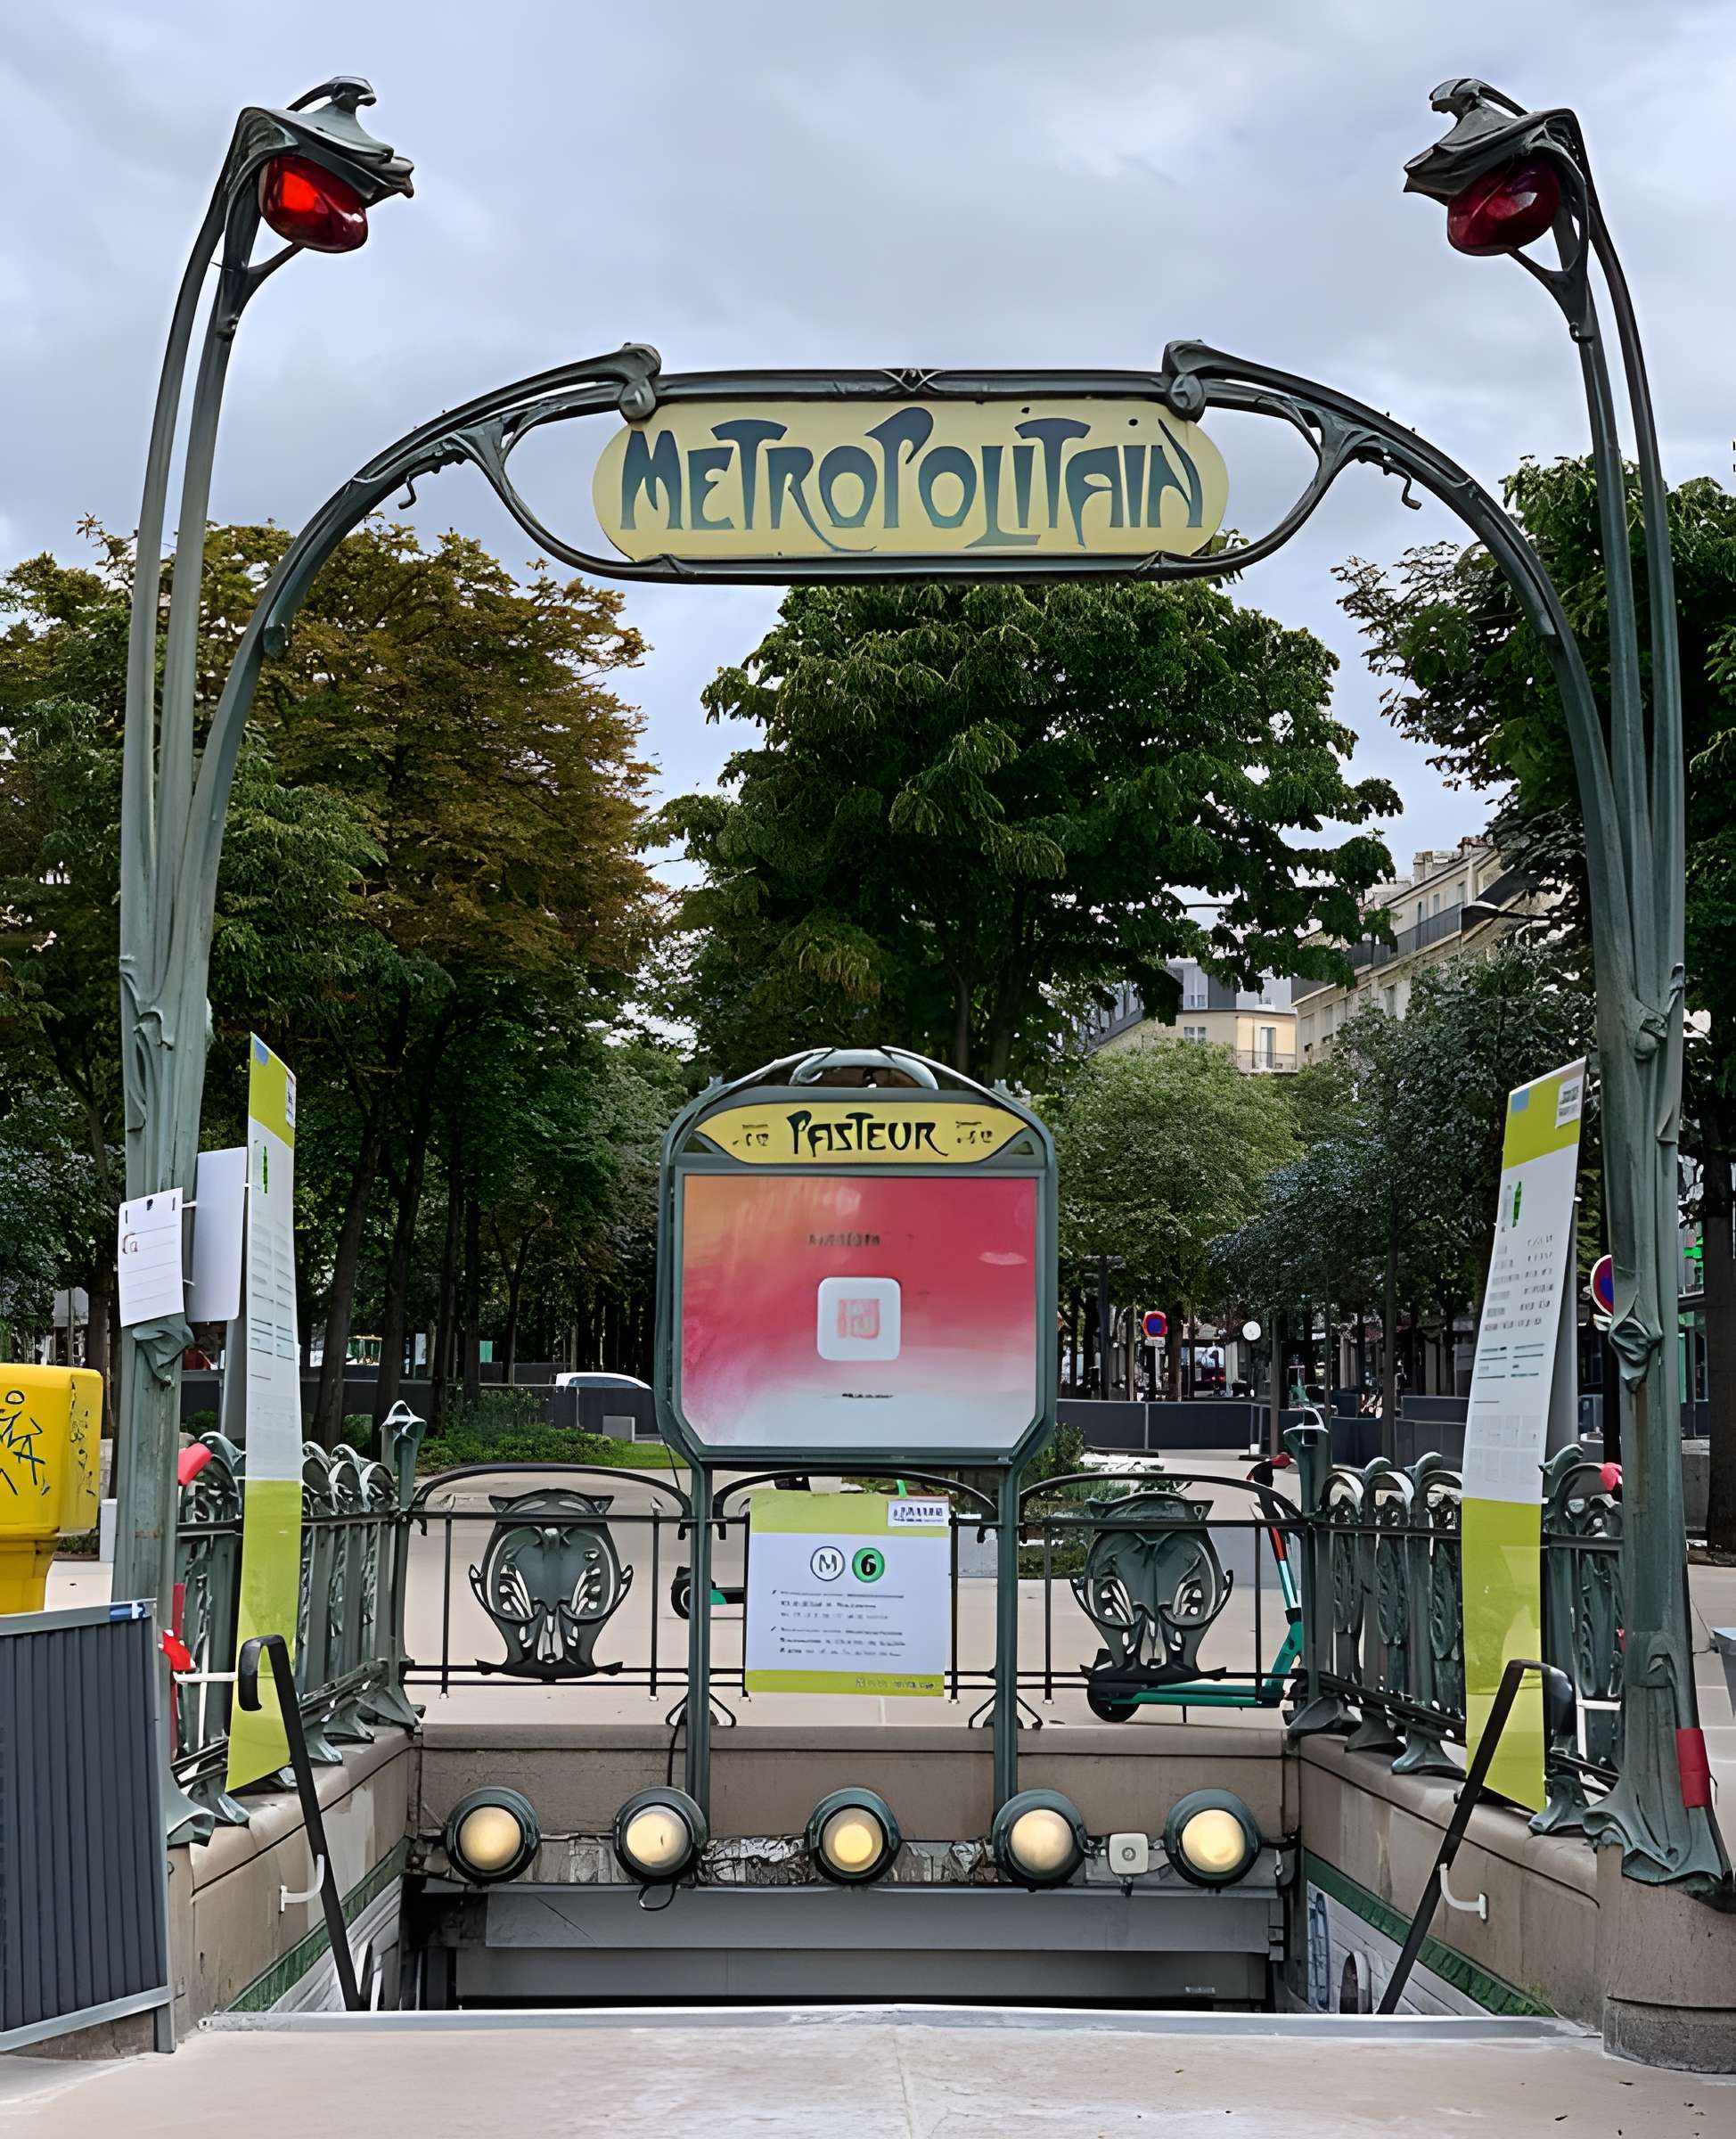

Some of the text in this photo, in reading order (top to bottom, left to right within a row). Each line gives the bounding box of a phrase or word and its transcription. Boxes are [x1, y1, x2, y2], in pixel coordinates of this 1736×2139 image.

[620, 406, 1203, 552] METROPOLITAIN
[786, 1110, 948, 1158] PASTEUR
[861, 1553, 877, 1577] 6
